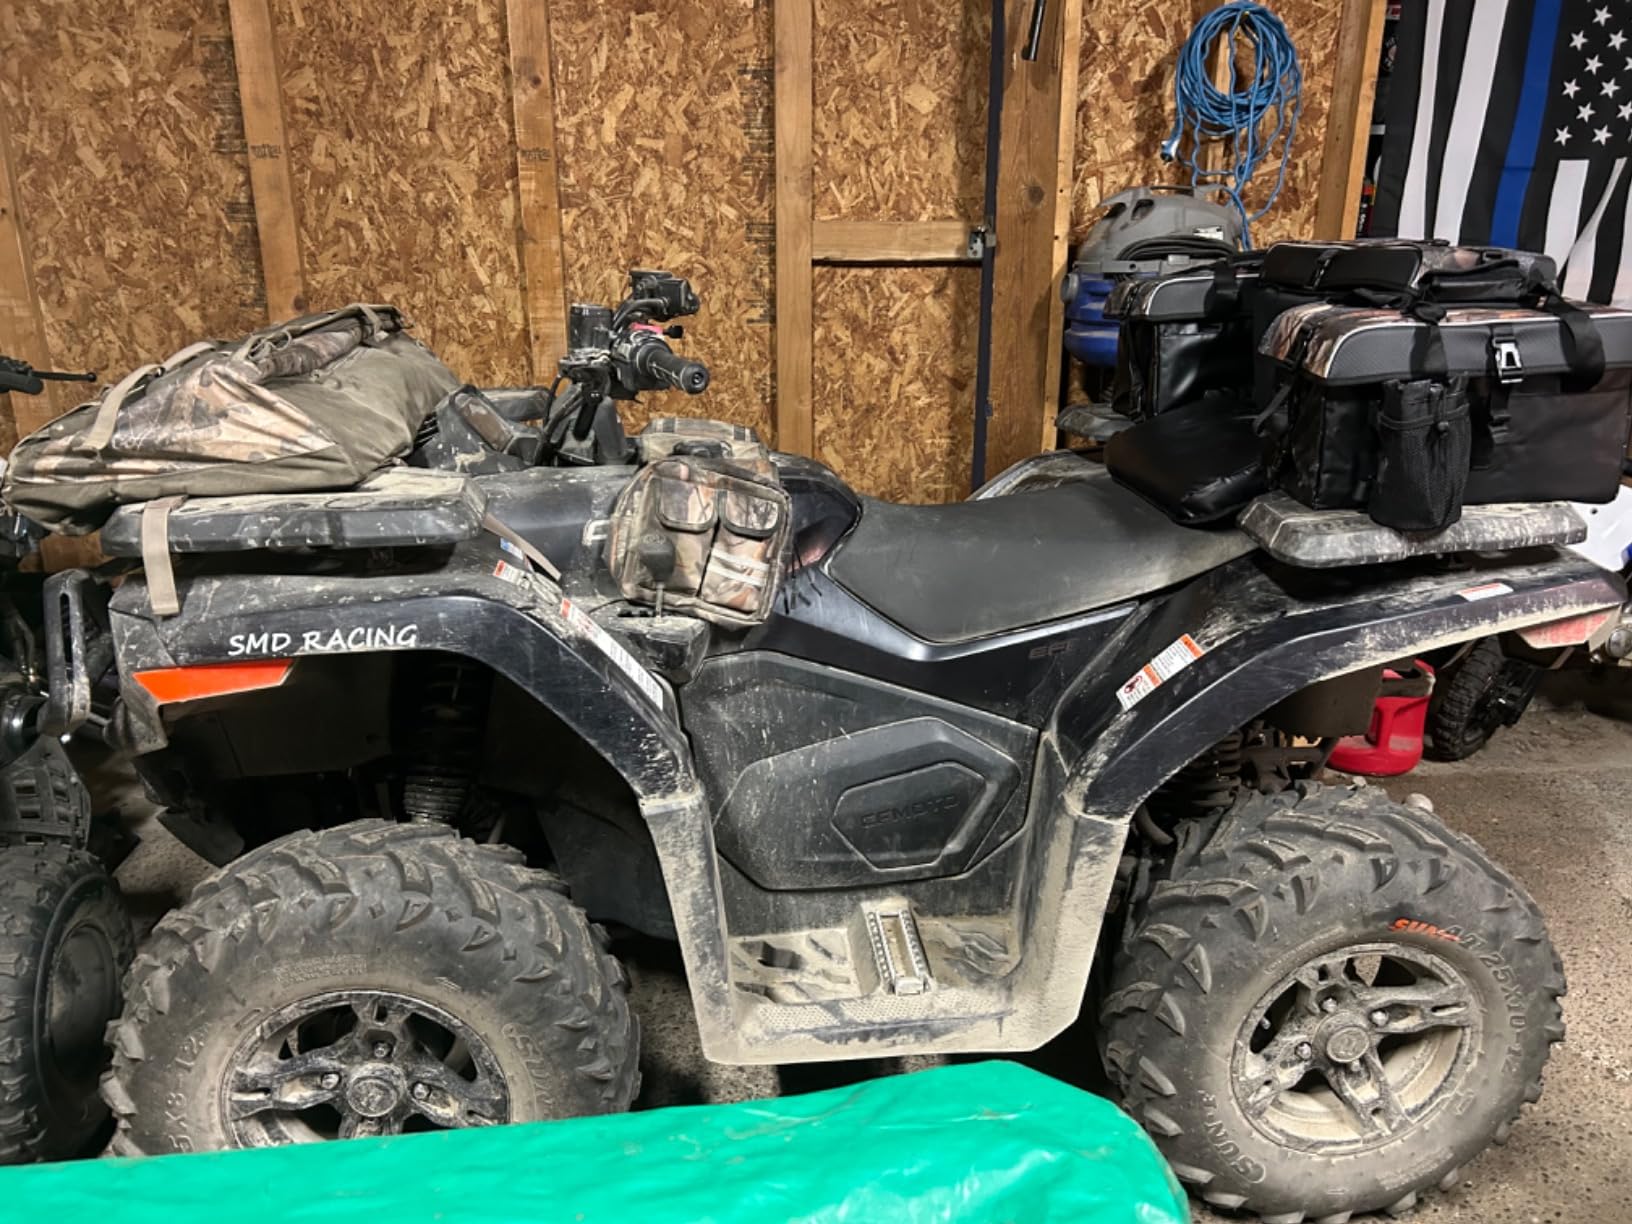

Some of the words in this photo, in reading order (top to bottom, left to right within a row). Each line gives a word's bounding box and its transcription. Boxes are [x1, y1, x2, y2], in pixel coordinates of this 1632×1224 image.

[227, 632, 291, 656] SMD
[302, 624, 418, 651] RACING
[861, 796, 959, 829] CFMOTO
